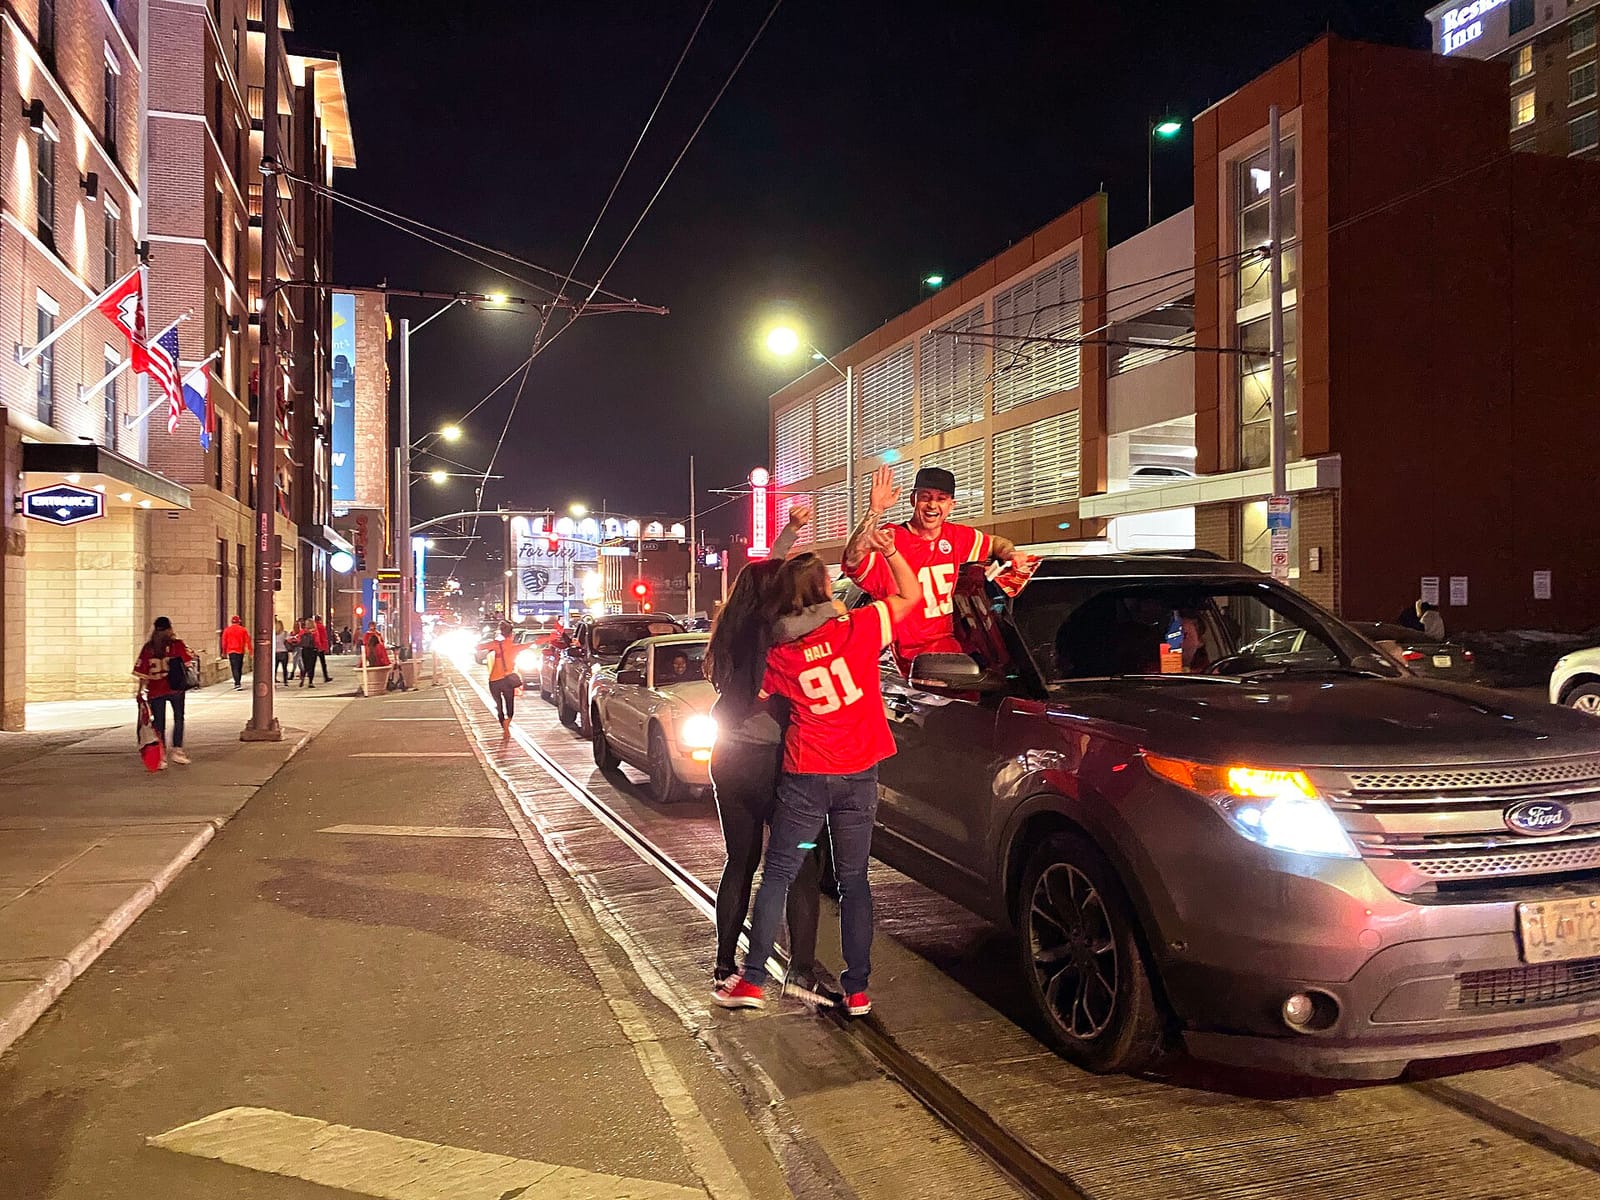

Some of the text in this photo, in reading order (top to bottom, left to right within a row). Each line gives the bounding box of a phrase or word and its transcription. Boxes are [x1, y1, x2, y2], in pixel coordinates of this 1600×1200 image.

[1441, 20, 1484, 55] Inn
[518, 542, 543, 558] For
[917, 563, 954, 619] 15
[803, 641, 832, 662] HALI
[798, 656, 864, 715] 91
[1528, 806, 1564, 827] Ford
